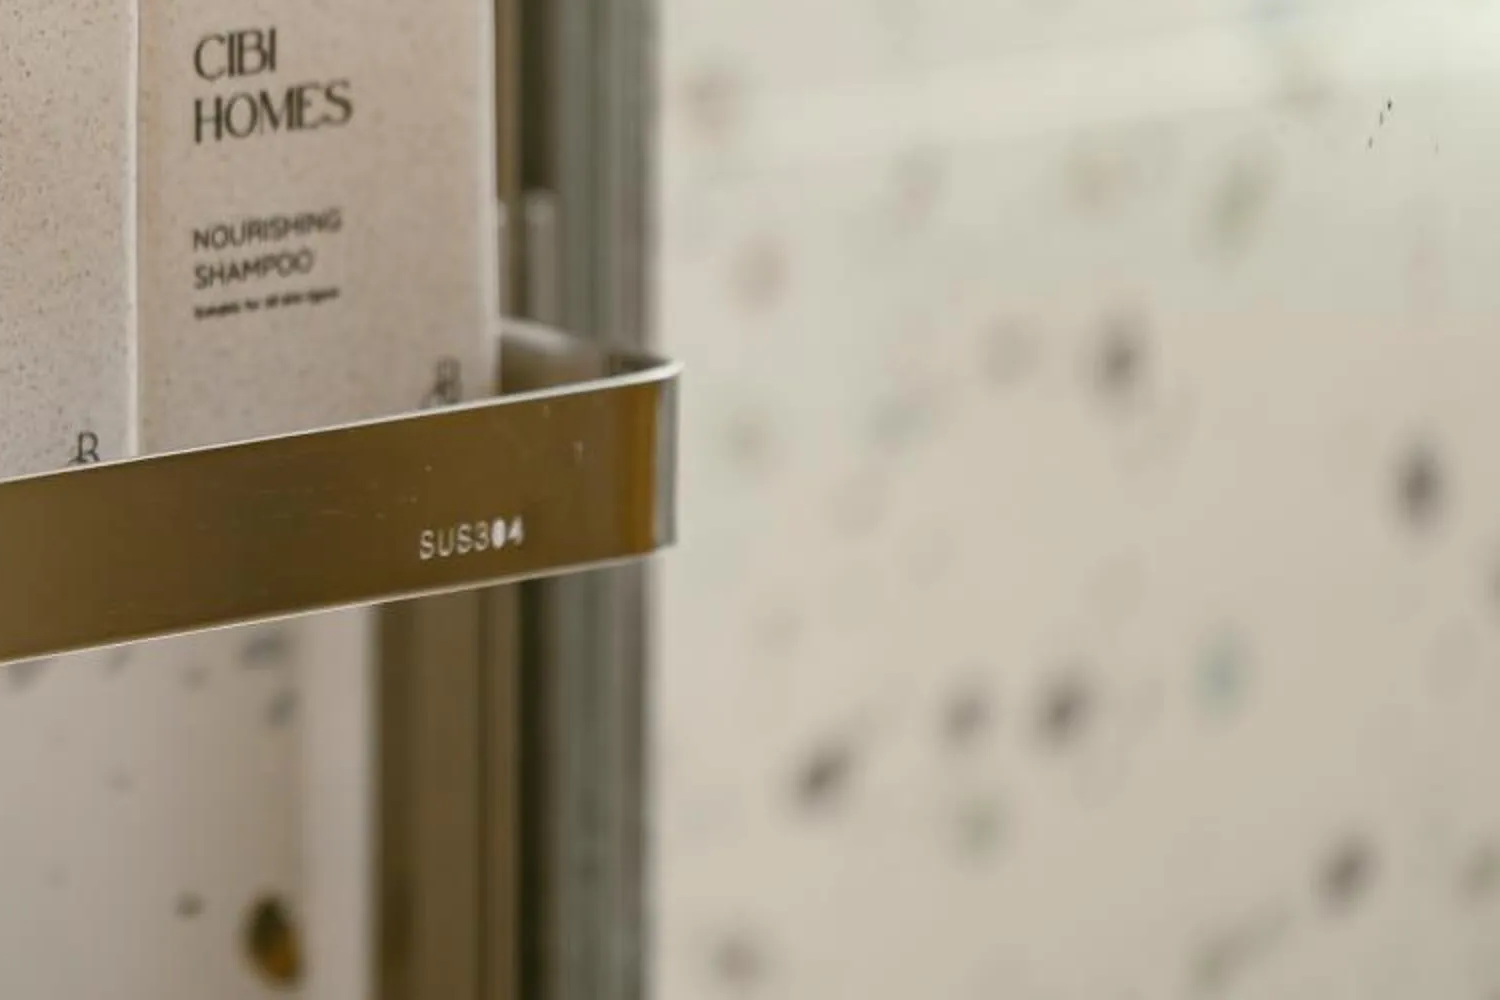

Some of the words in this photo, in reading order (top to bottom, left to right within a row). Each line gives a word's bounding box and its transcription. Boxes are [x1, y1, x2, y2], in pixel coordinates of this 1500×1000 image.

[194, 26, 276, 80] CIBI
[194, 80, 353, 143] HOMES
[193, 207, 342, 251] NOURISHING
[194, 249, 315, 290] SHAMPOO
[419, 515, 524, 560] SUS304
